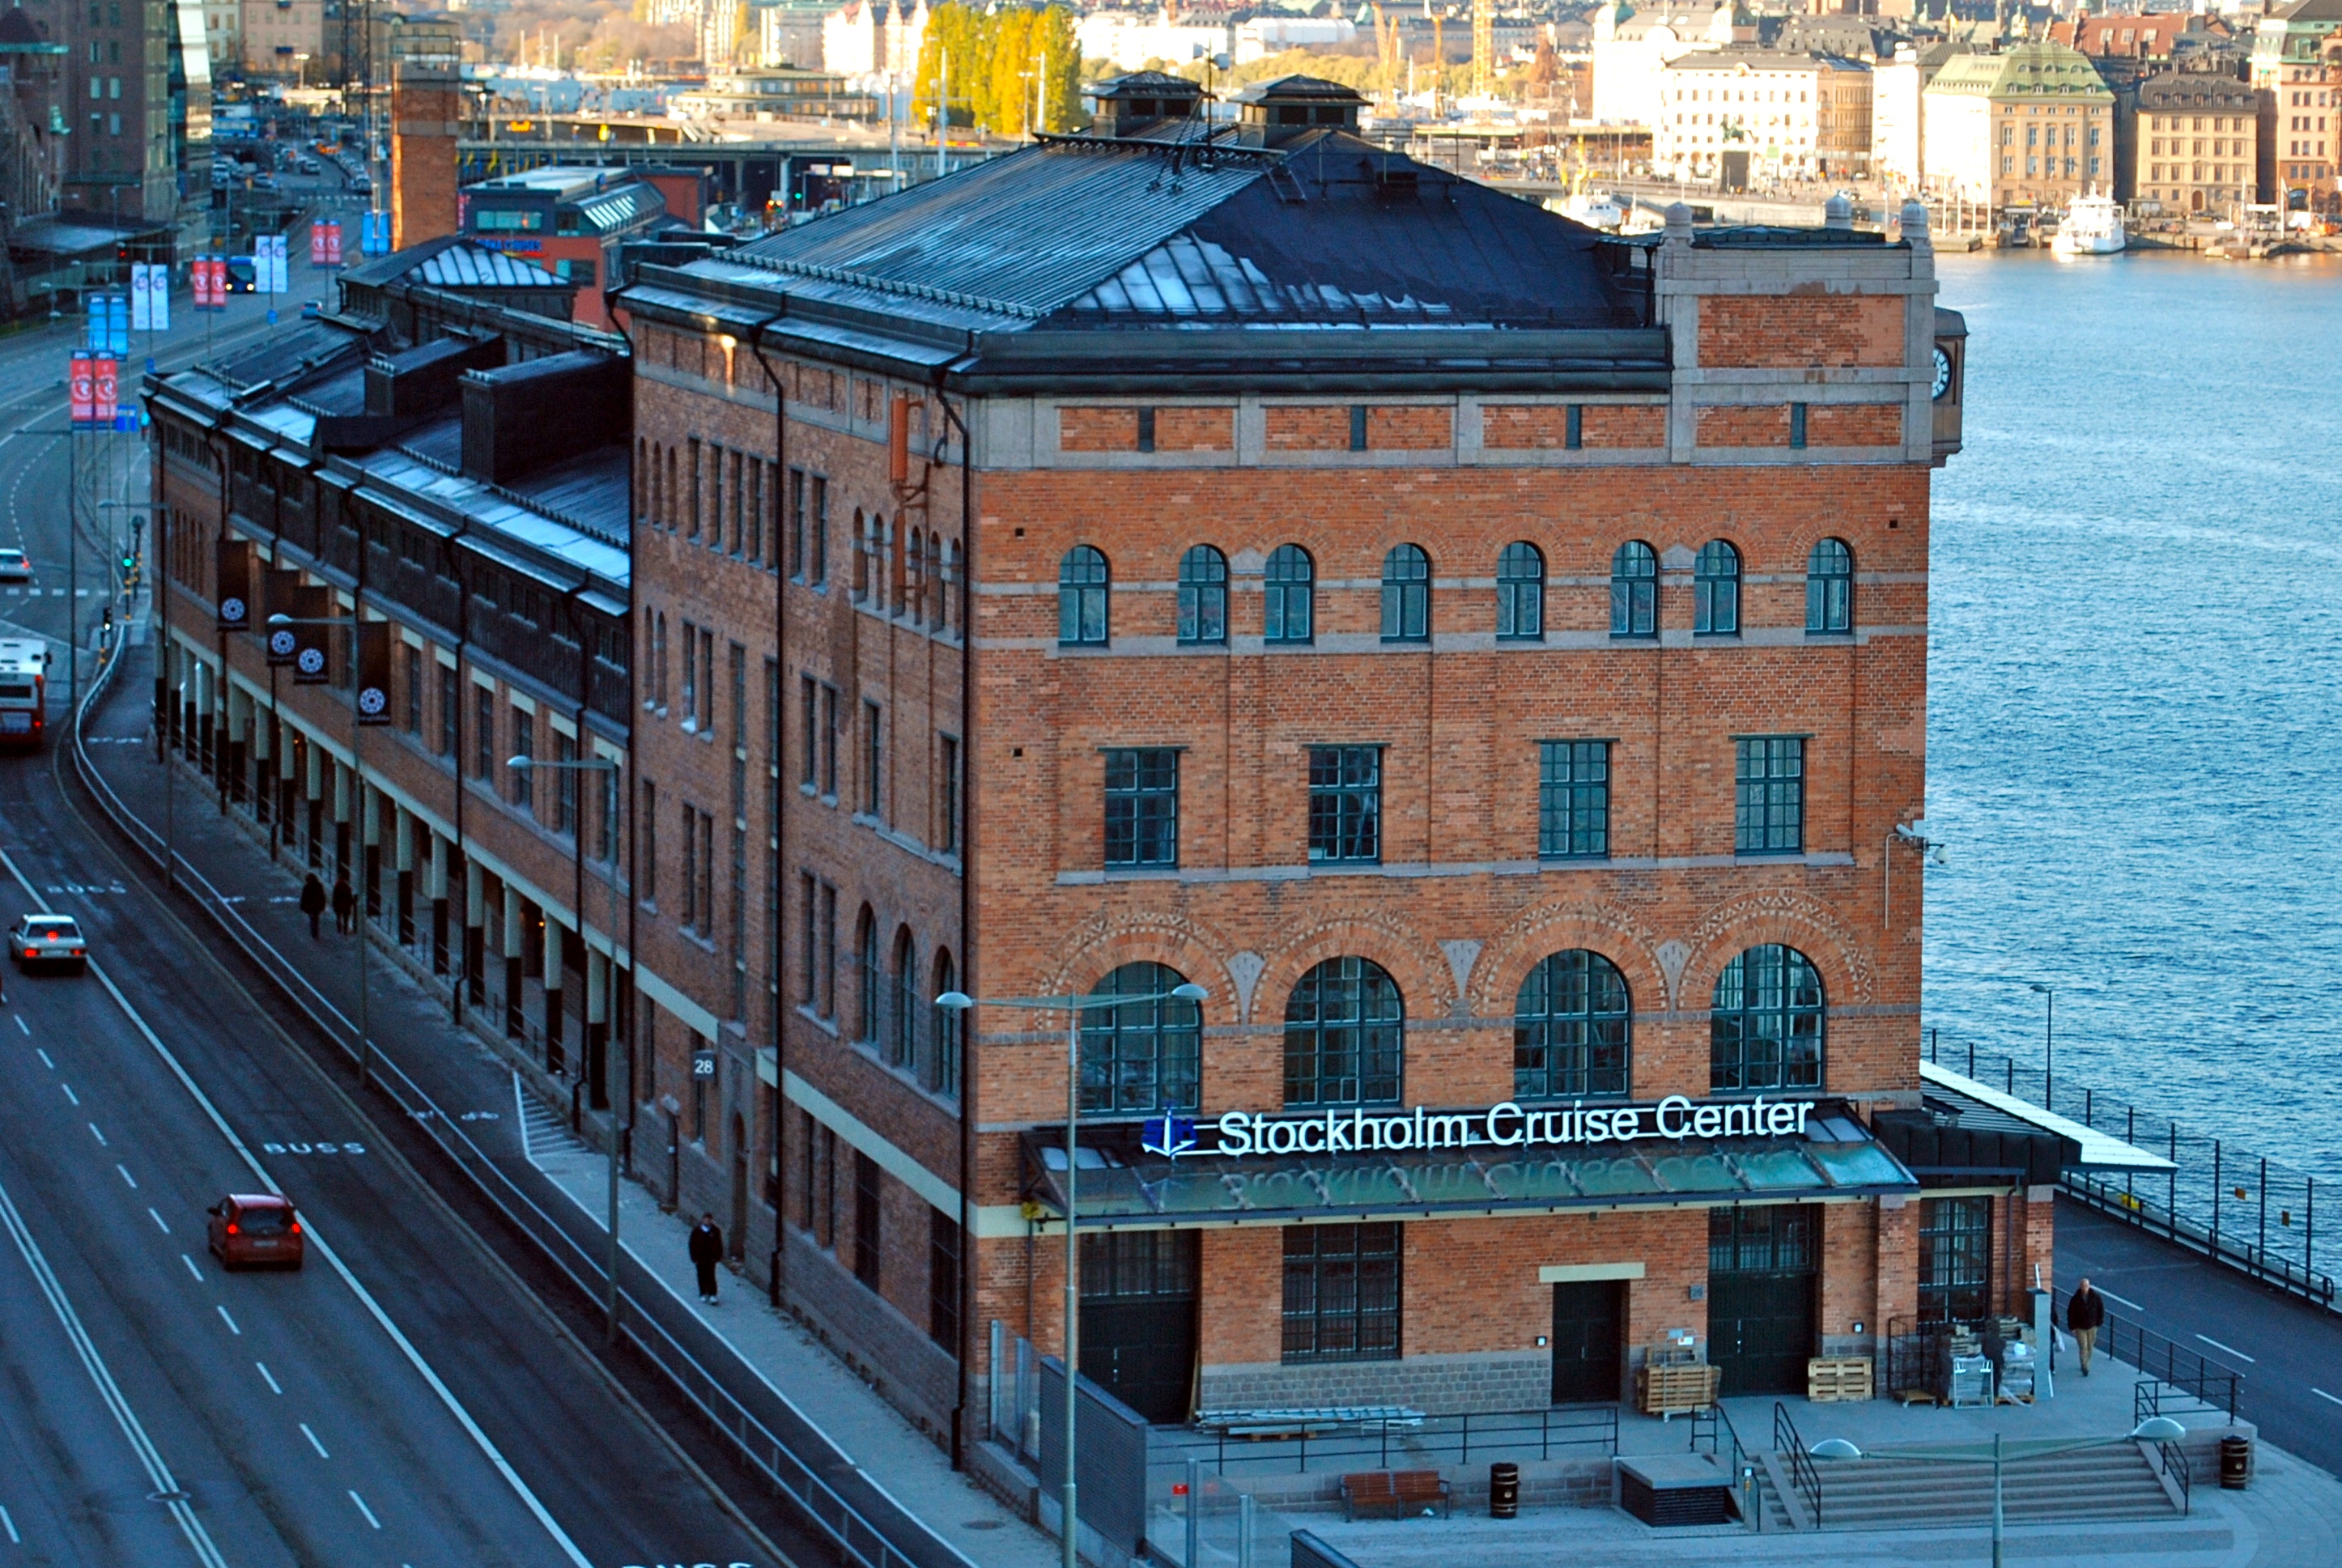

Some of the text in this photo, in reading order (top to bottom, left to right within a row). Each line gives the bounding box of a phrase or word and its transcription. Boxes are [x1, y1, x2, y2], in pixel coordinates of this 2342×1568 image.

[695, 1059, 713, 1074] 28
[1218, 1106, 1469, 1155] Stockholm
[1486, 1099, 1639, 1145] Cruise
[1656, 1094, 1814, 1139] Center
[263, 1141, 366, 1154] BUSS
